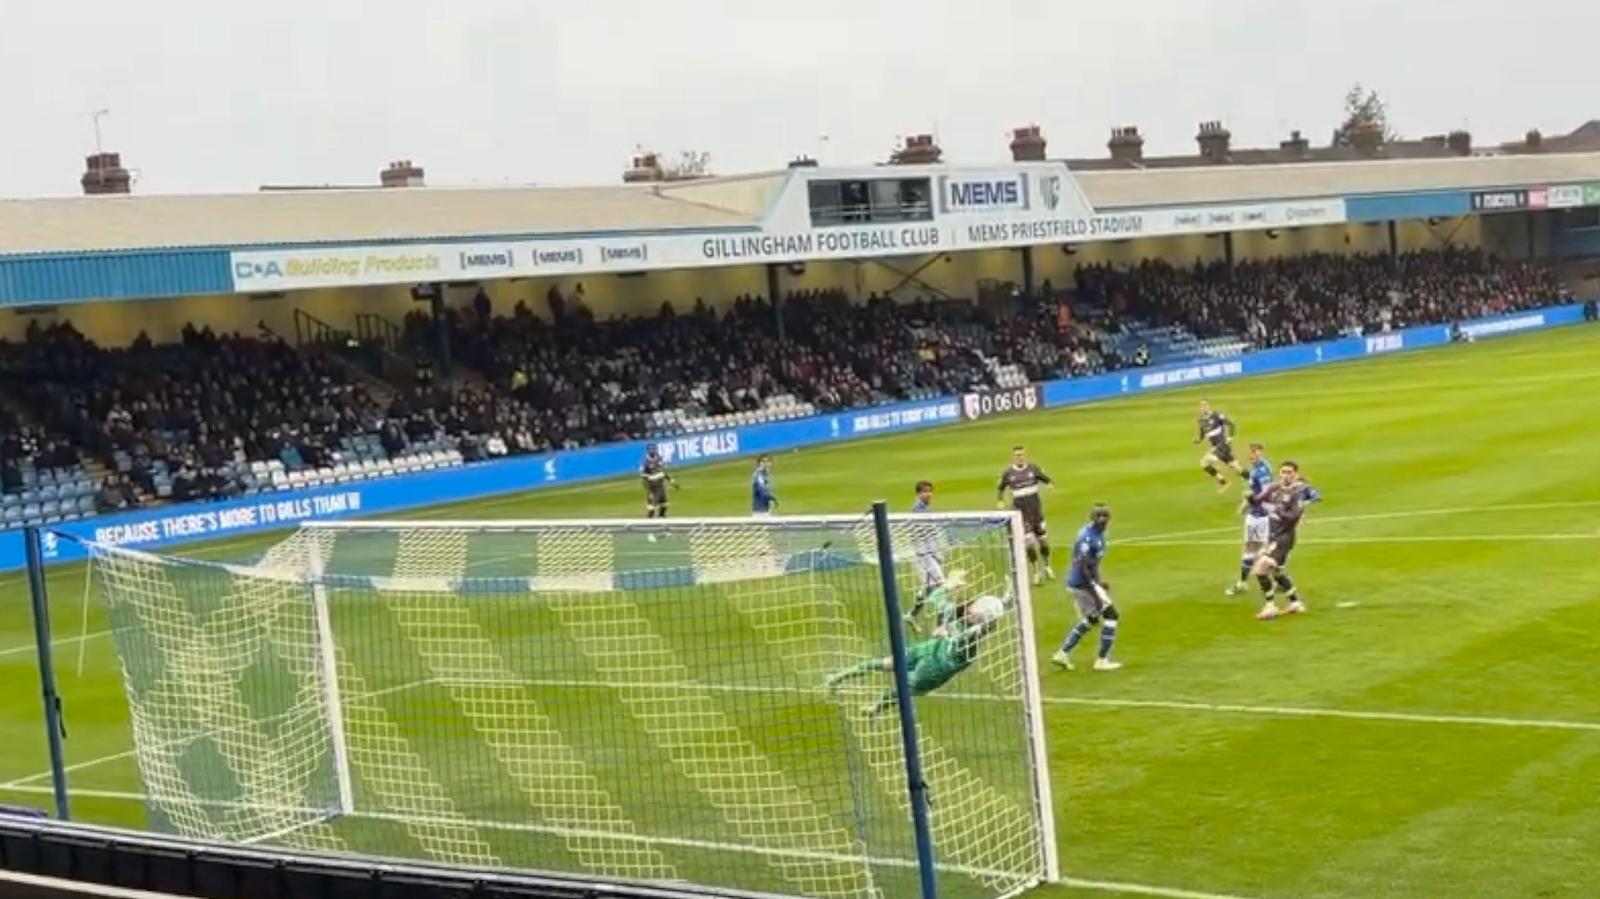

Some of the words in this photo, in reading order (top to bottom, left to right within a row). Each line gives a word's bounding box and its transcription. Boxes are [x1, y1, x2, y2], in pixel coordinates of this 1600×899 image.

[951, 181, 1018, 205] MEMS
[968, 223, 1008, 242] MEMS
[1012, 219, 1087, 240] PRIESTFIELD
[1089, 216, 1143, 235] STADIUM
[702, 233, 812, 258] GILLINGHAM
[816, 229, 897, 252] FOOTBALL
[901, 228, 939, 246] CLUB
[286, 257, 360, 277] Building
[364, 254, 440, 271] Products
[676, 438, 700, 460] THE
[702, 432, 739, 455] GILLS!
[95, 520, 161, 544] BECAUSE
[162, 512, 217, 536] THERE'S
[220, 506, 257, 528] MORE
[260, 503, 276, 523] TO
[277, 499, 312, 520] GILLS
[313, 495, 346, 514] THAN
